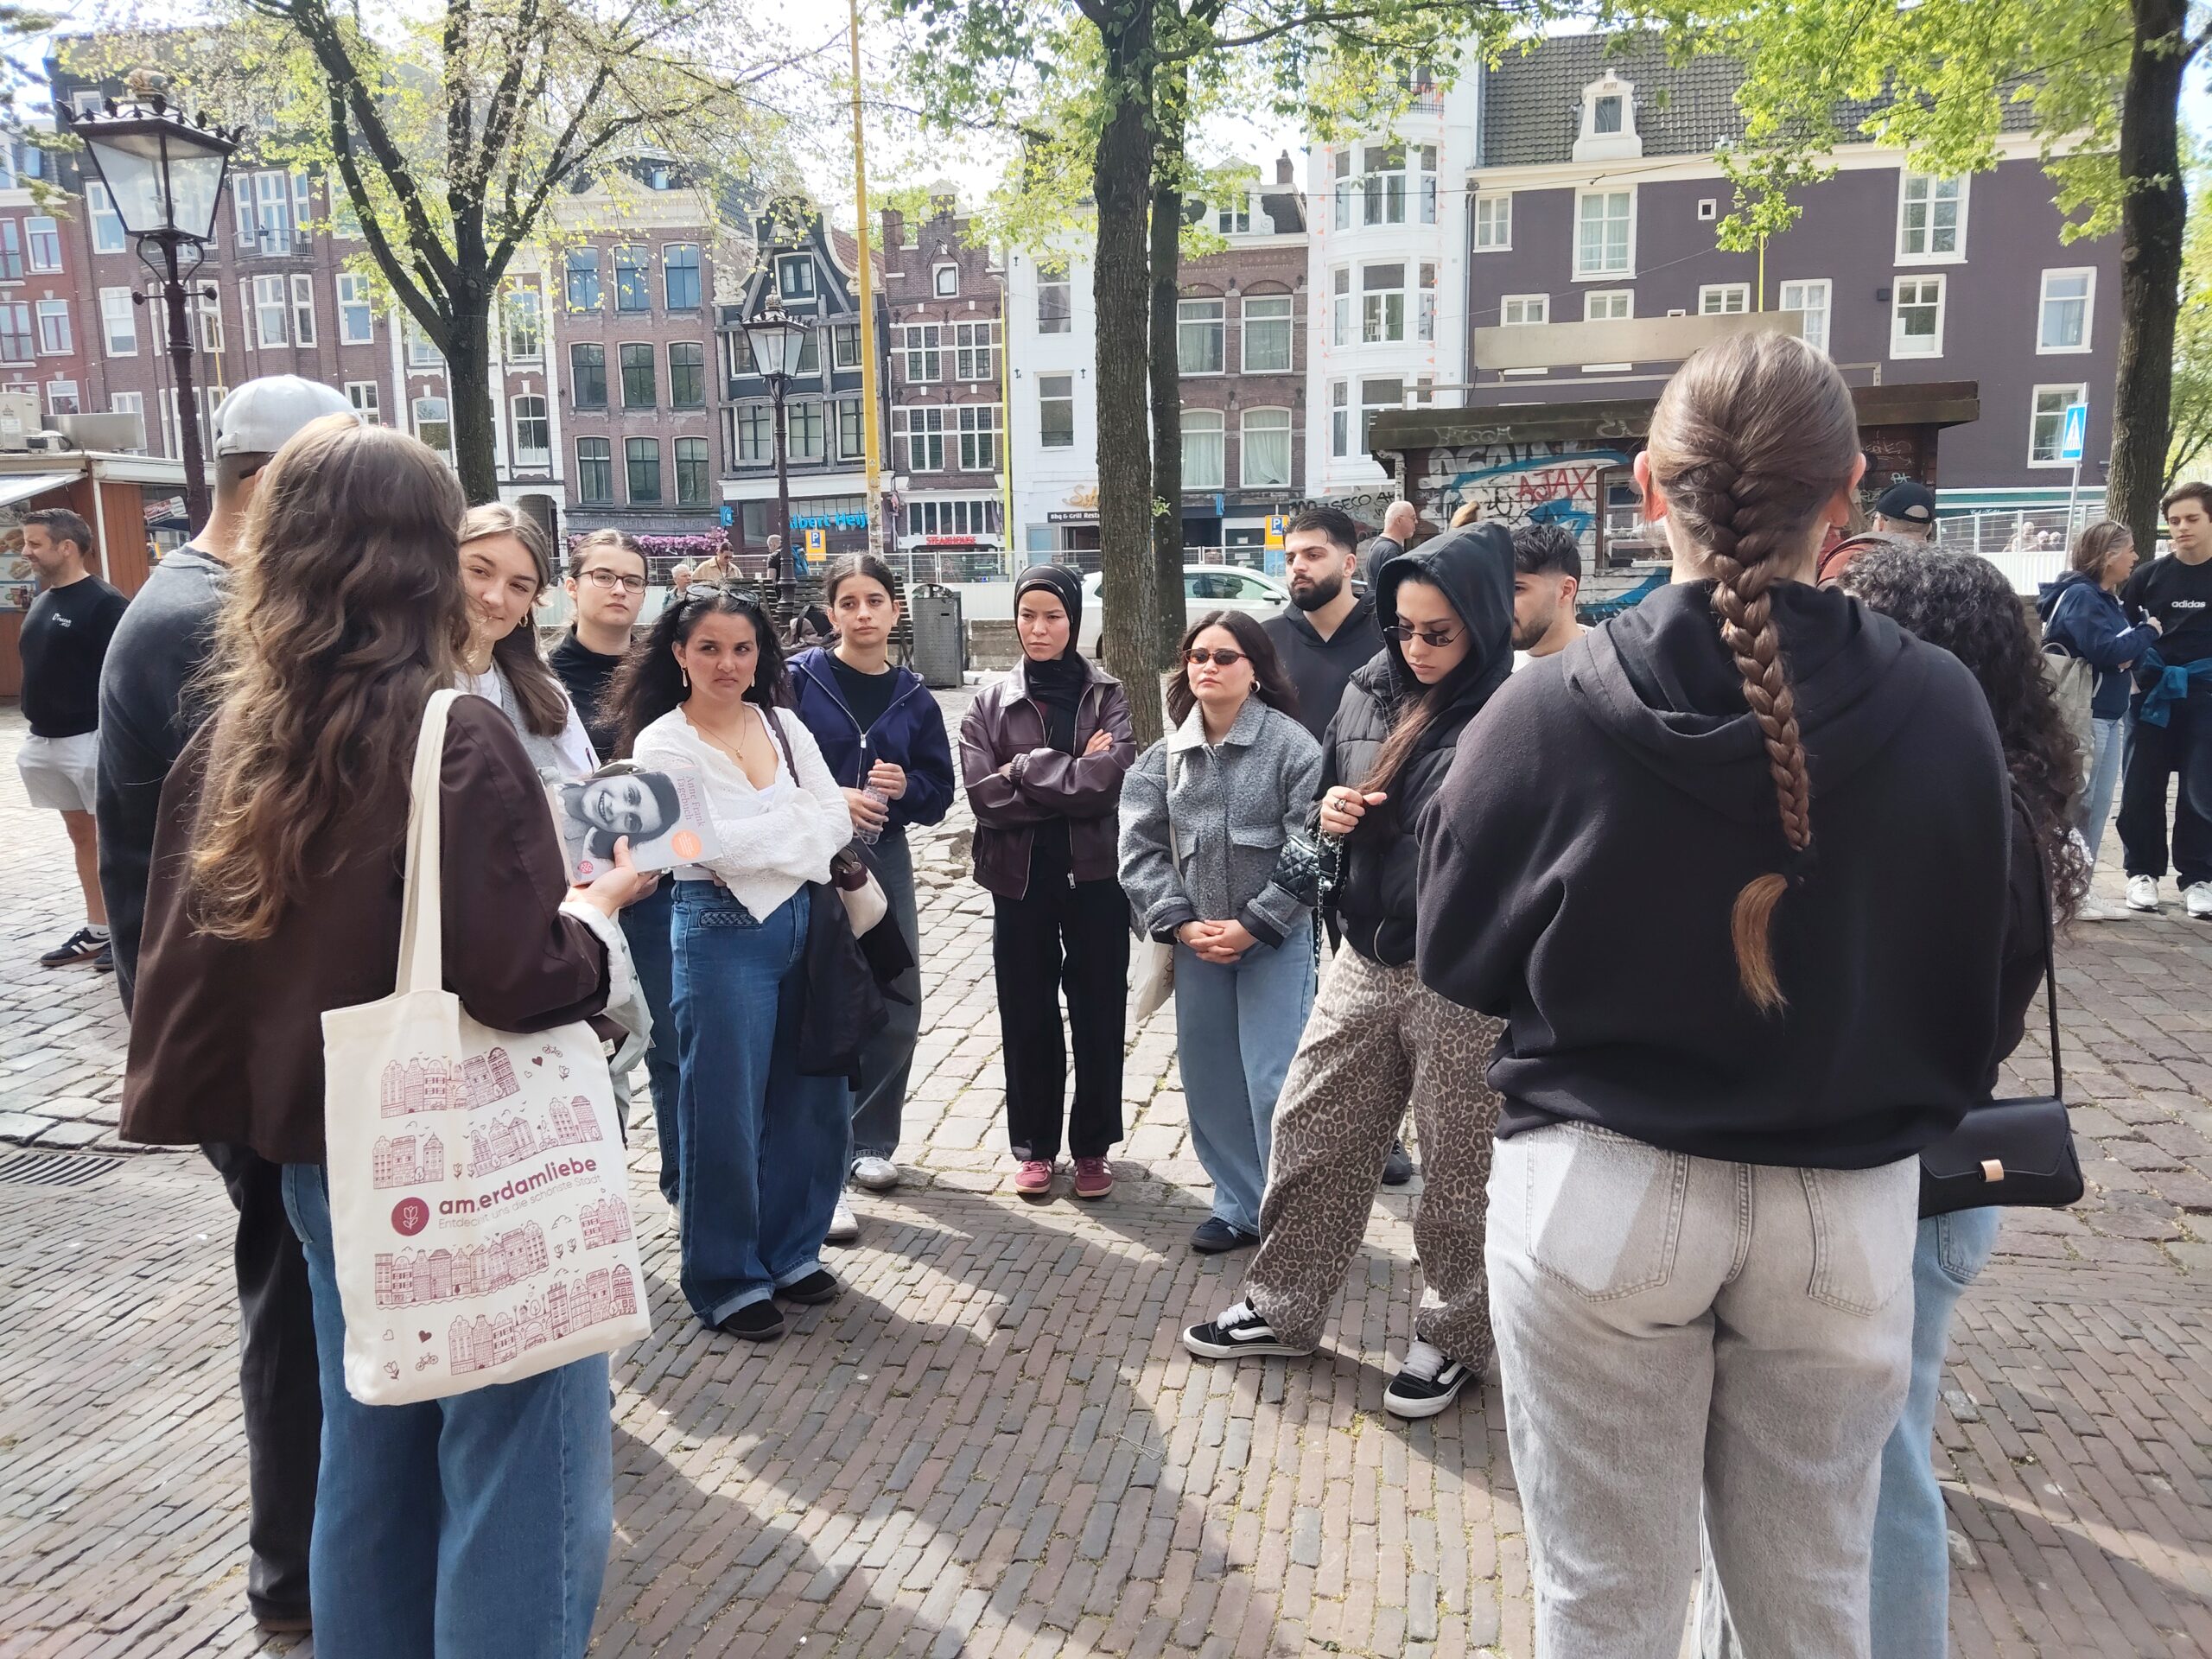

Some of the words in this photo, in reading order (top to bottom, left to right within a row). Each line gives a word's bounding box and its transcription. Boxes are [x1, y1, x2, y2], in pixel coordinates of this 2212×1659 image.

[1517, 465, 1598, 504] AJAX
[1331, 494, 1372, 512] SECO
[835, 510, 868, 529] Heij
[1273, 518, 1281, 529] P
[812, 532, 819, 542] P
[925, 536, 976, 544] STEAKHOUSE
[2171, 600, 2206, 608] adidas
[677, 776, 694, 820] Tagebuch
[692, 801, 706, 827] Frank
[493, 1206, 511, 1219] uns
[512, 1198, 528, 1211] die
[574, 1174, 602, 1187] Stadt
